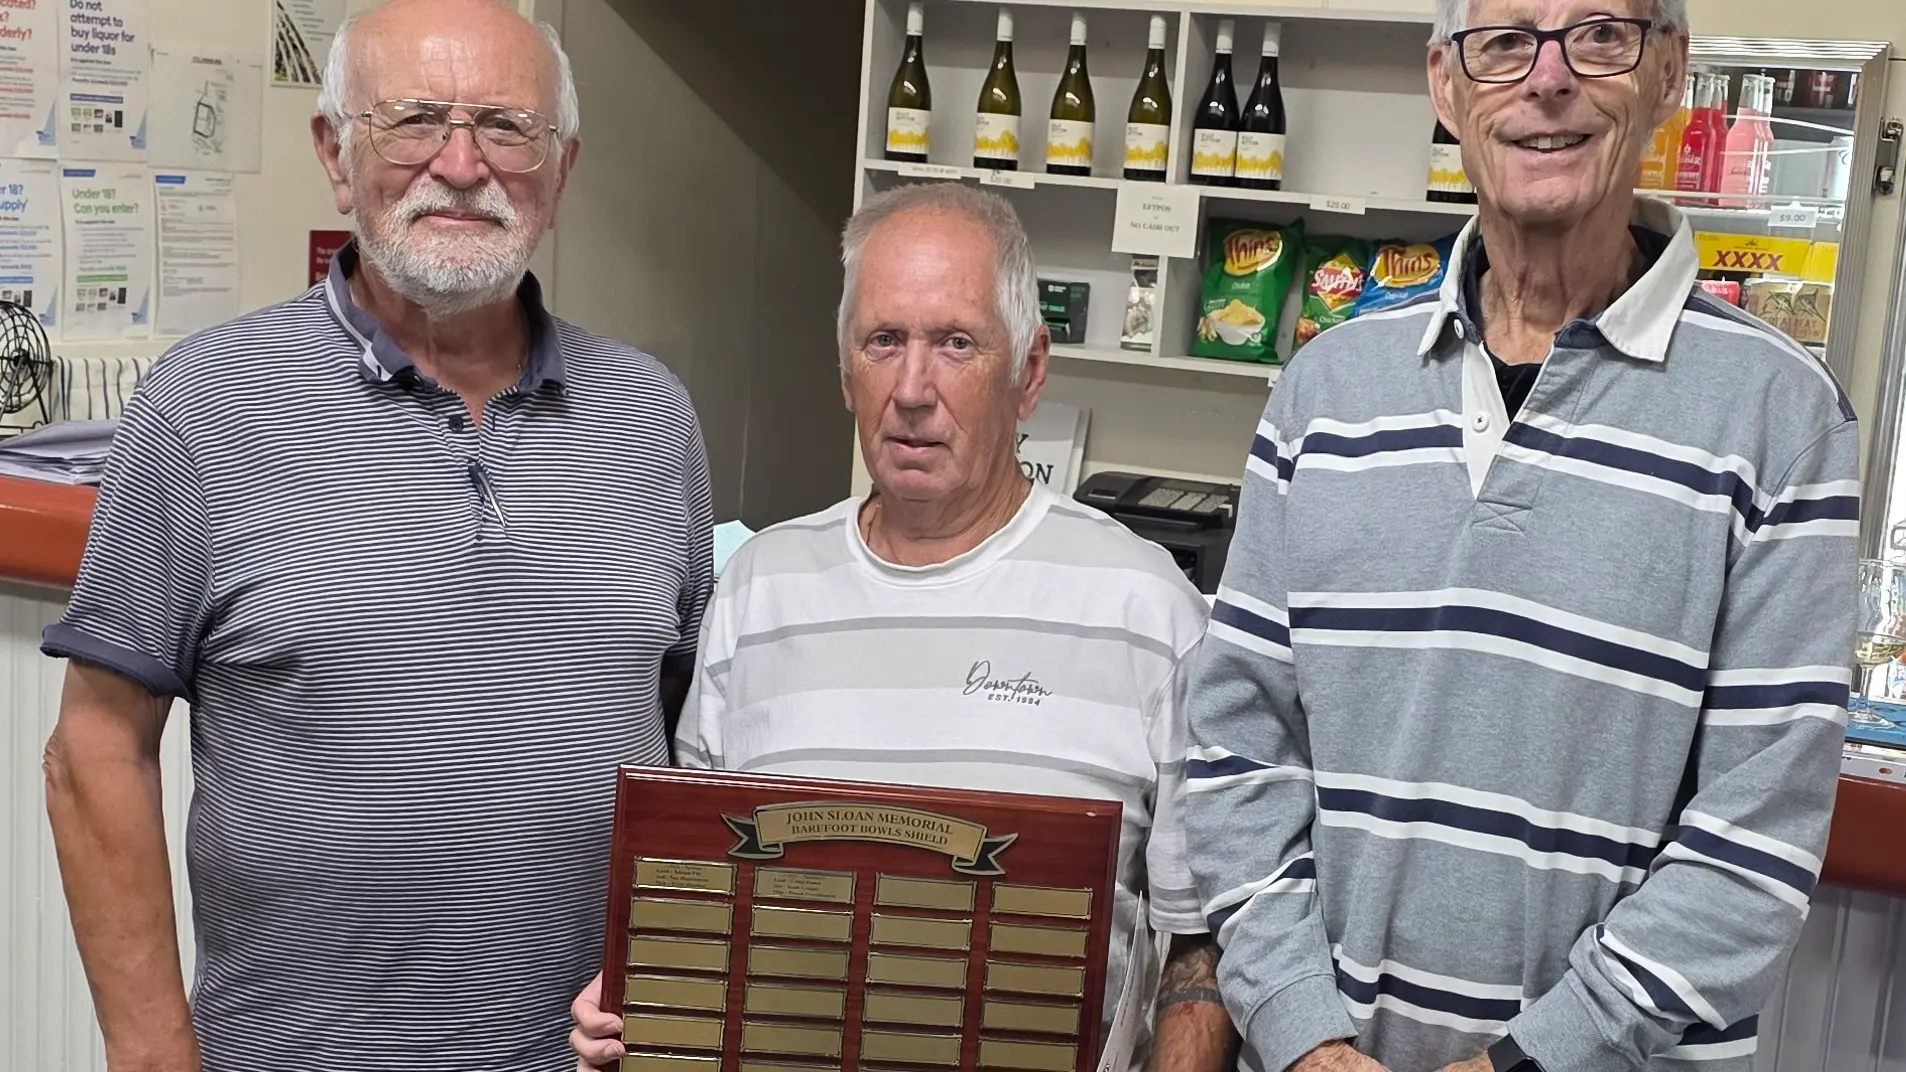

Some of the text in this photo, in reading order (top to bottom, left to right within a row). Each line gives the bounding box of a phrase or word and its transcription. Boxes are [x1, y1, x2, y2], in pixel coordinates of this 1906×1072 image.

[69, 0, 102, 11] Do not
[70, 12, 123, 27] attempt to
[71, 25, 135, 42] buy liquor for
[71, 41, 99, 53] under
[72, 188, 116, 199] Under 18?
[73, 202, 139, 215] Can you enter?
[1142, 203, 1172, 212] EFTPOS
[1326, 199, 1351, 210] $20.00
[1780, 213, 1806, 222] $9.00
[1130, 221, 1180, 233] NO CASH OUT
[1226, 231, 1277, 267] Thins
[1378, 247, 1433, 279] Thins
[1712, 249, 1784, 271] XXXX
[1310, 264, 1365, 295] Smith's
[1014, 432, 1029, 454] Y
[1020, 460, 1054, 485] ON
[987, 693, 1012, 702] EST.
[786, 810, 954, 835] JOHN SLOAN MEMORIAL
[791, 824, 948, 846] BAREFOOT BOWLS SHIELD
